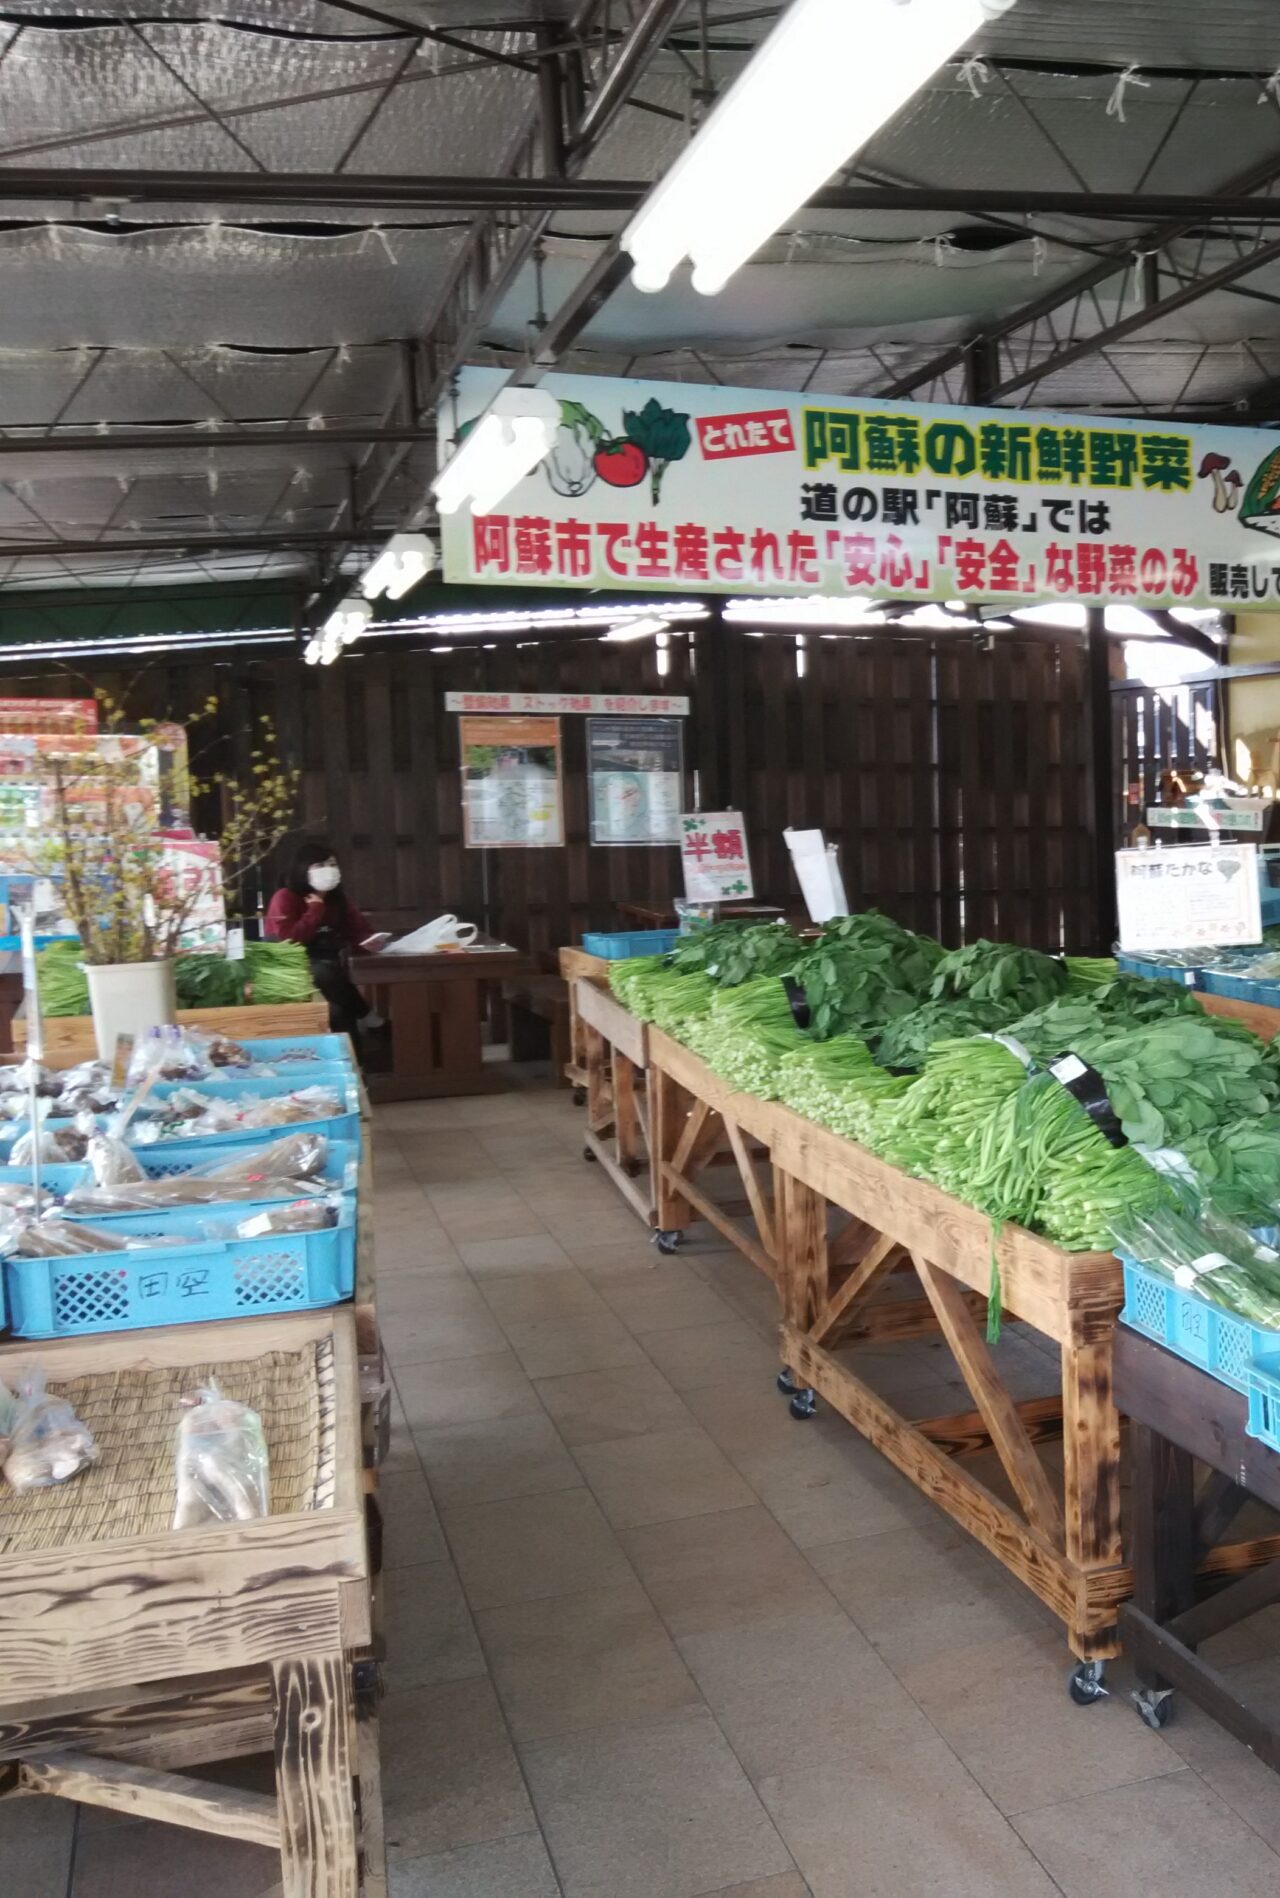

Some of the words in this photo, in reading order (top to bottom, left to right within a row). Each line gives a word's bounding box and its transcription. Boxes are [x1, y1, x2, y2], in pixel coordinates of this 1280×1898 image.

[702, 417, 793, 453] とれたて
[803, 408, 1193, 491] 阿蘇の新鮮野菜
[801, 482, 1111, 534] 道の駅「阿蘇」では
[472, 514, 1199, 597] 阿蘇市で生産された「安心」「安全」な野菜のみ
[682, 829, 744, 862] 半額
[1131, 861, 1213, 878] 阿蘇たかな
